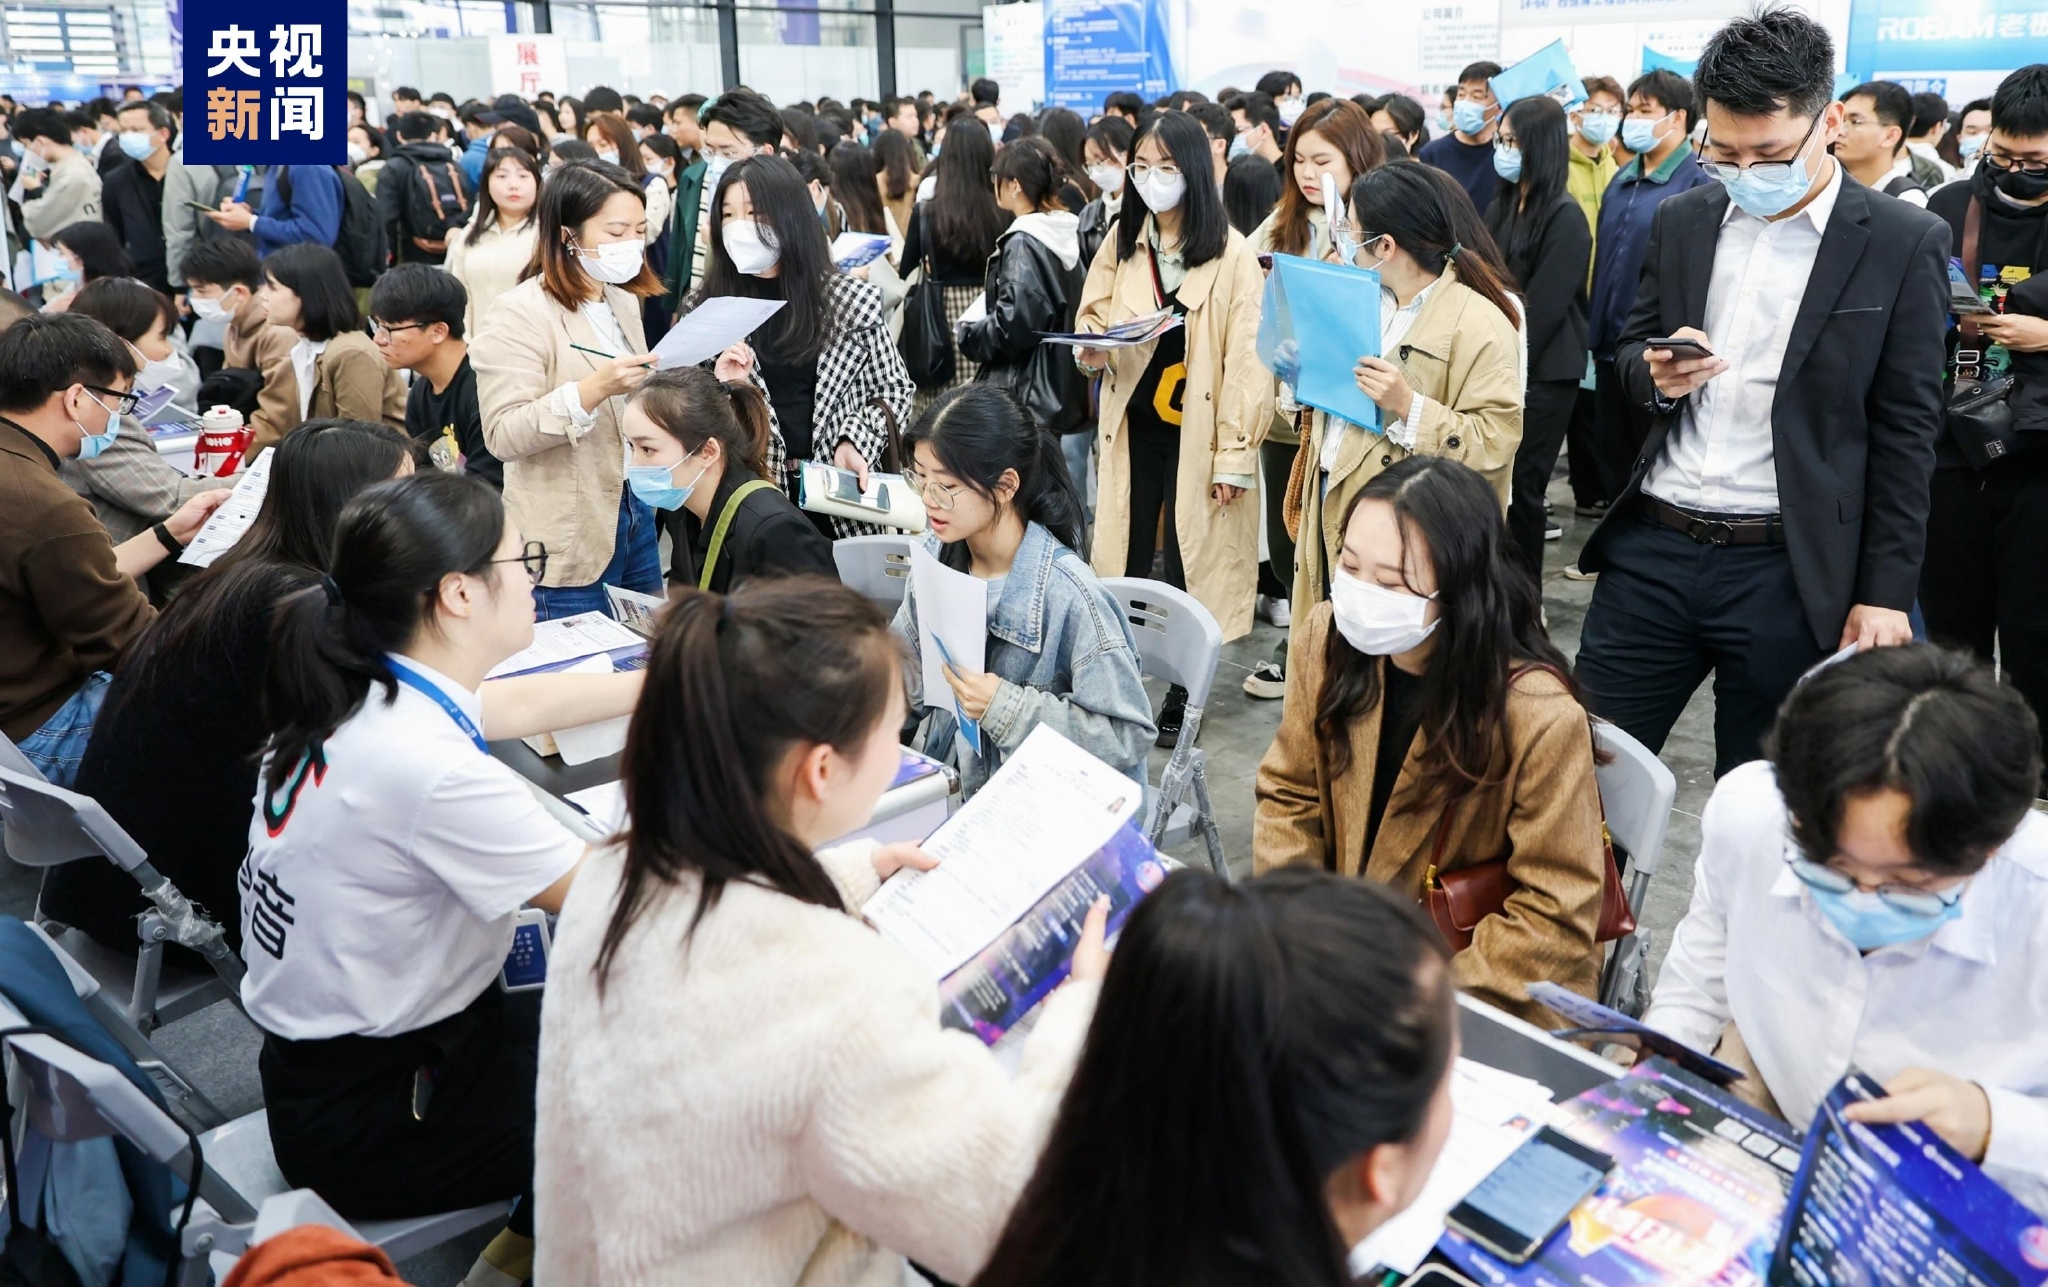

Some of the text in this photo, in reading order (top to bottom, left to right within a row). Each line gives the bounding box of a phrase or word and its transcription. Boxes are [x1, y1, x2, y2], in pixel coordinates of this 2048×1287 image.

[1877, 14, 1996, 41] ROBAM
[517, 43, 541, 93] 展厅
[1897, 79, 1946, 97] 司简介
